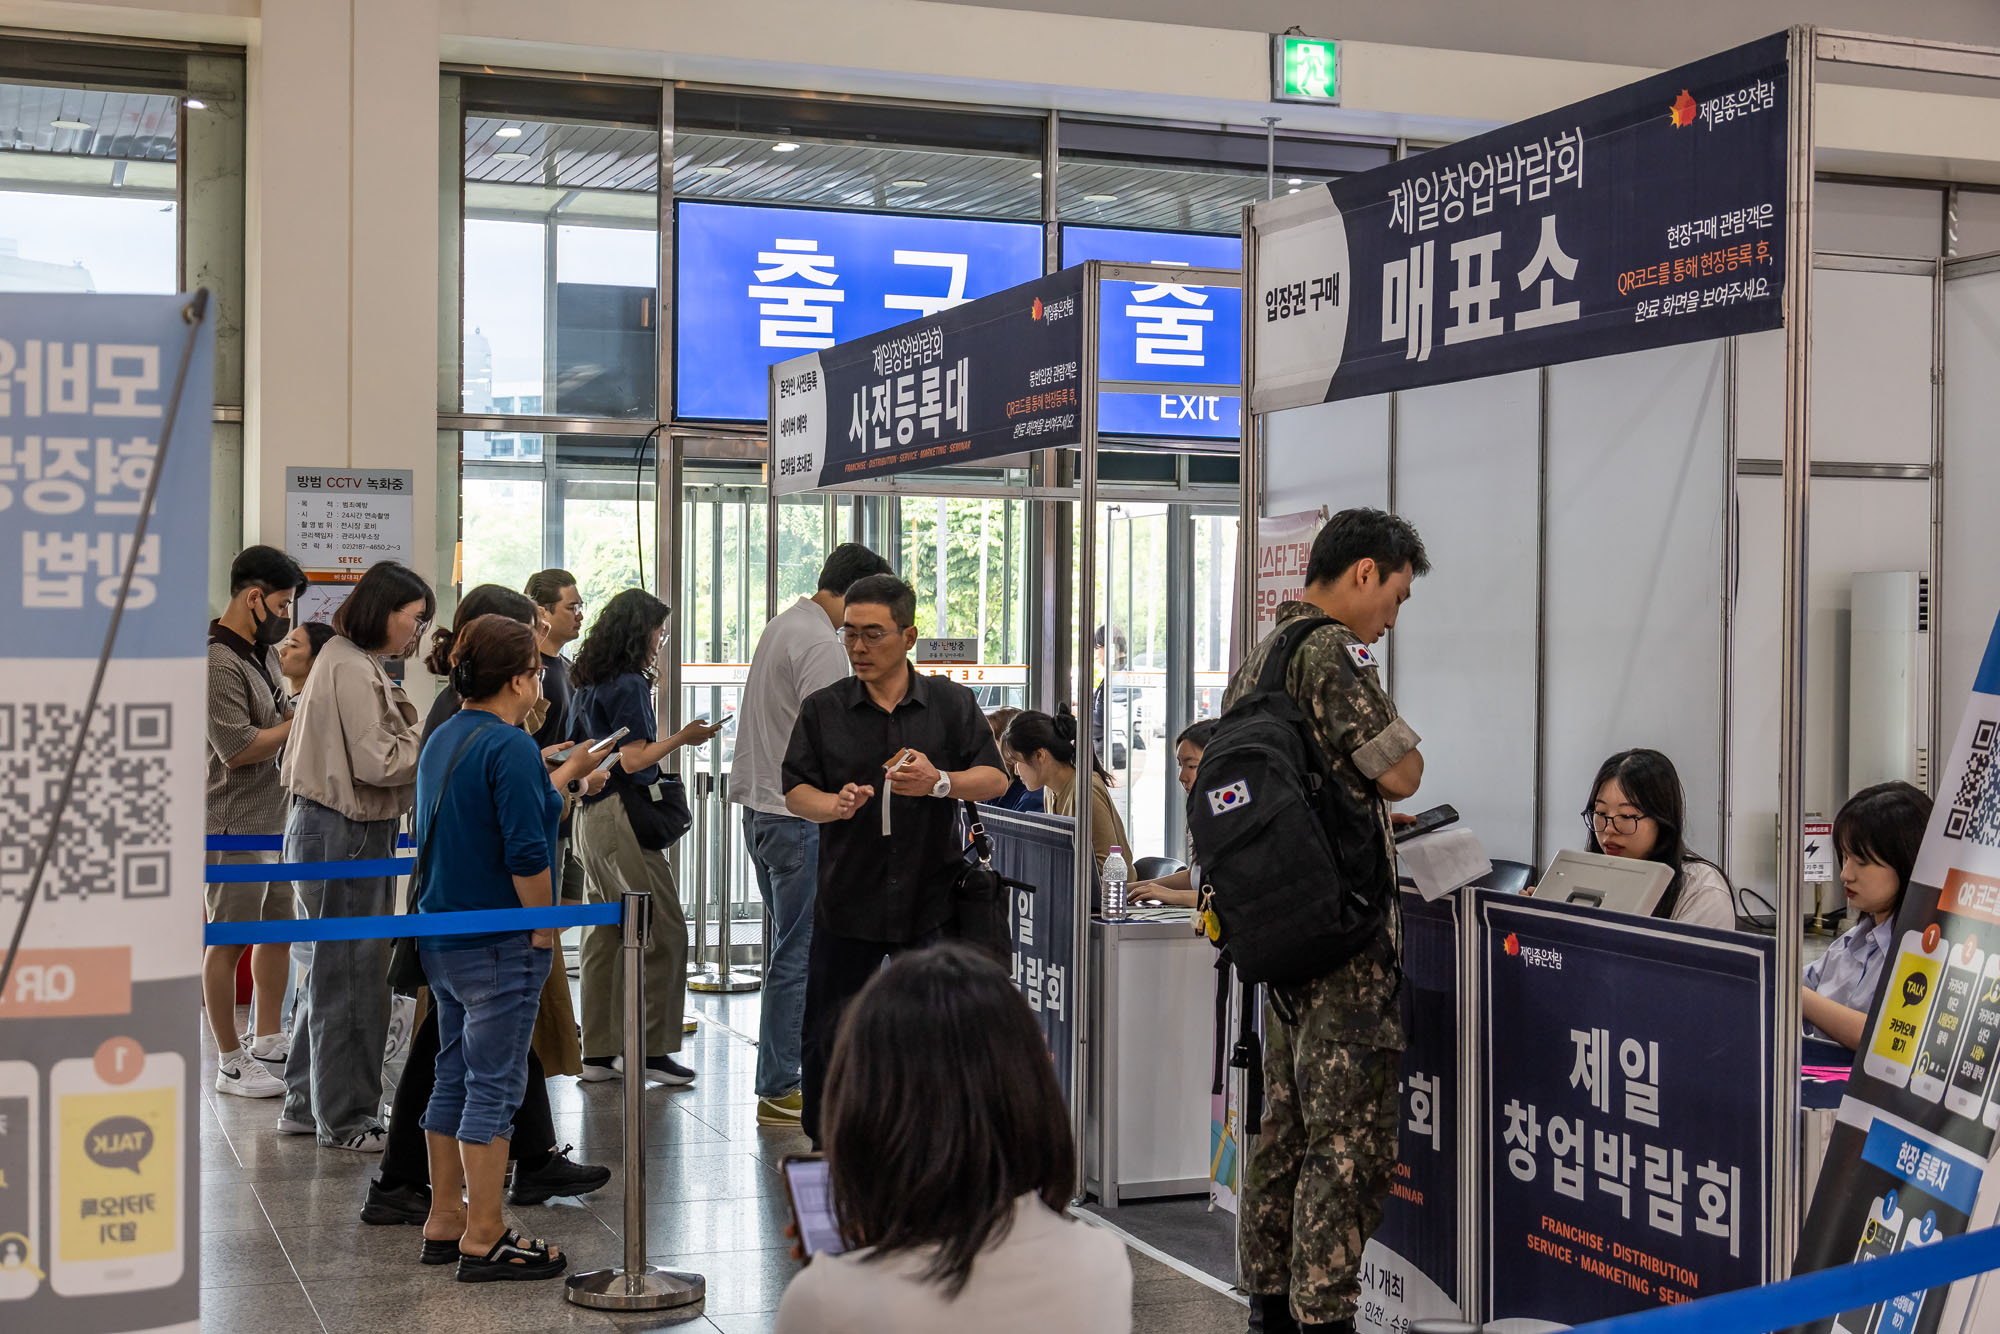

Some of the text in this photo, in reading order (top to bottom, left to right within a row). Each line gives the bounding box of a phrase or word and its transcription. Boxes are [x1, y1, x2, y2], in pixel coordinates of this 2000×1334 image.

[1700, 79, 1775, 131] 제일좋은전람
[1388, 127, 1584, 235] 제일창업박람회
[1667, 203, 1774, 249] 현장구매 관람객은
[1618, 240, 1773, 296] QR코드를 통해 현장등록 후,
[1266, 272, 1340, 322] 입장권 구매
[1381, 215, 1580, 361] 매표소
[1635, 277, 1770, 322] 완료 화면을 보여주세요.
[872, 326, 944, 376] 제일창업박람회
[781, 370, 817, 399] 온라인 사전등록
[1029, 361, 1077, 388] 동반입장 관람객은
[849, 357, 969, 454] 사전등록대
[781, 413, 807, 437] 네이버 예약
[781, 452, 812, 476] 모바일 초대권
[899, 449, 918, 463] SERVICE
[919, 444, 947, 459] MARKETING
[298, 476, 405, 490] 방범 CCTV 녹화중
[341, 512, 363, 520] 24시간
[342, 501, 369, 509] 범죄예방
[341, 522, 361, 530] 전시장
[341, 532, 380, 540] 관리사무소장
[338, 556, 363, 564] SETEC
[333, 573, 363, 582] 비상대피
[1008, 886, 1034, 947] 일
[1928, 929, 1937, 946] 1
[1907, 981, 1926, 997] TALK
[1889, 1018, 1917, 1039] 카카오톡
[1892, 1037, 1906, 1053] 열기
[1569, 1027, 1660, 1128] 제일
[1399, 1068, 1440, 1151] 회
[1503, 1099, 1740, 1258] 창업박람회
[1896, 1141, 1951, 1192] 현장 등록자
[1887, 1196, 1893, 1212] 1
[1923, 1217, 1932, 1234] 2
[1527, 1233, 1572, 1265] SERVICE
[1580, 1254, 1649, 1296] MARKETING
[1541, 1215, 1698, 1289] FRANCHISE DISTRIBUTION
[1357, 1261, 1404, 1304] 시 개최
[1365, 1301, 1384, 1327] 인천
